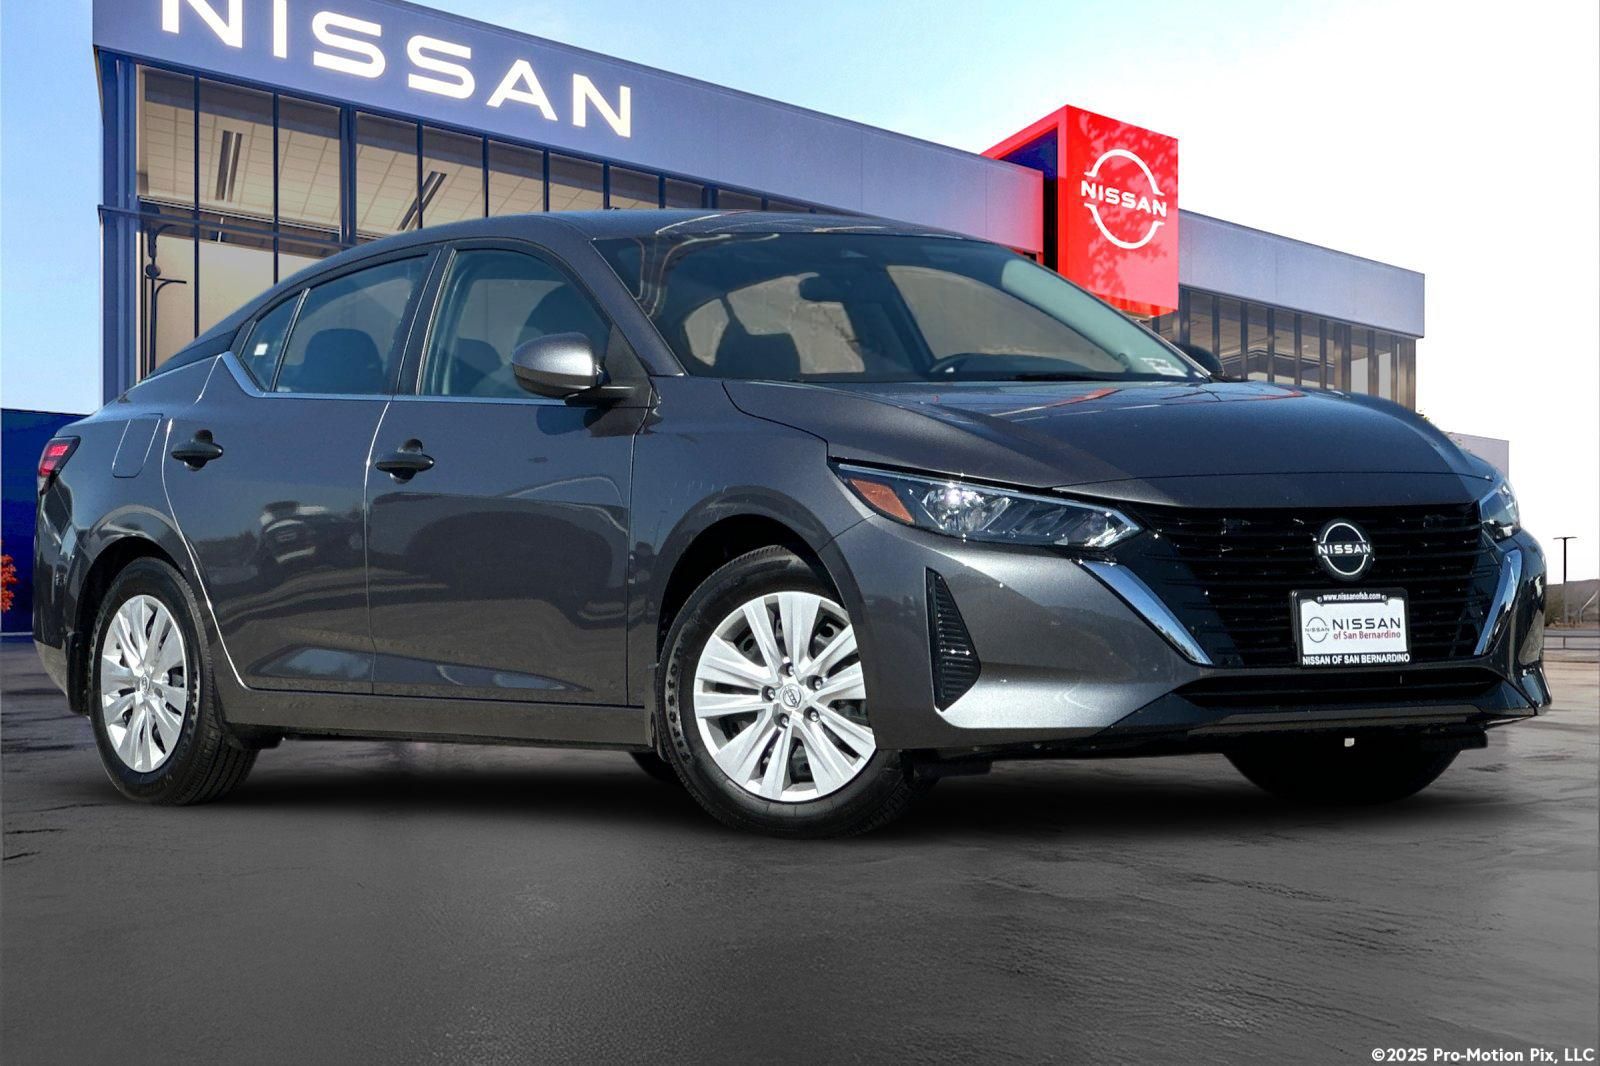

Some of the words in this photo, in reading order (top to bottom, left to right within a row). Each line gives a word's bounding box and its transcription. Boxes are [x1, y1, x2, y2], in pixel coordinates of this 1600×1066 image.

[162, 0, 632, 138] NISSAN
[1081, 180, 1167, 217] NISSAN
[1317, 543, 1371, 555] NISSAN
[1323, 592, 1381, 601] www.nissanofsb.com
[1332, 617, 1401, 630] NISSAN
[1333, 631, 1342, 640] of
[1343, 631, 1358, 640] San
[1359, 630, 1401, 639] Bernardino
[1302, 655, 1330, 665] NISSAN
[1332, 654, 1343, 664] OF
[1344, 654, 1360, 664] SAN
[1361, 653, 1410, 663] BERNARDINO
